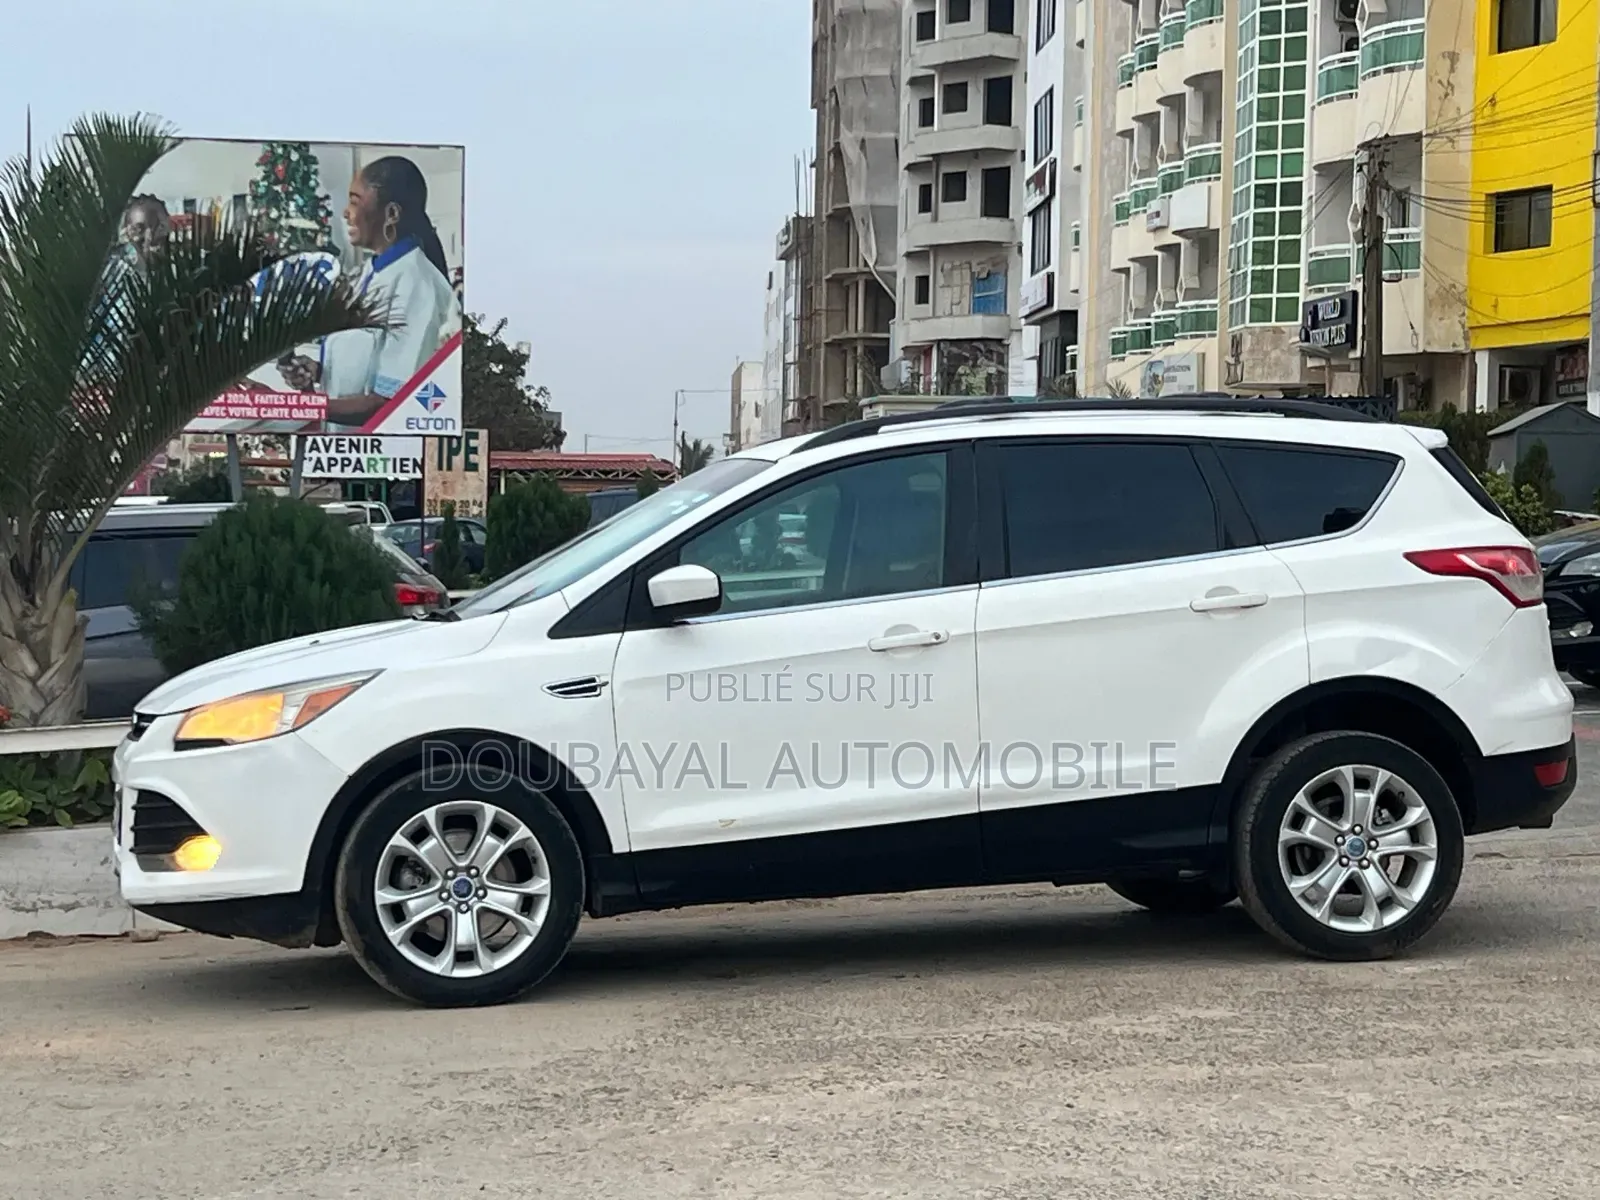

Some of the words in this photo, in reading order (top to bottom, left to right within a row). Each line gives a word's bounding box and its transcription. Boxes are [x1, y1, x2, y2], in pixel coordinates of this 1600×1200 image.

[254, 393, 286, 405] FAITES
[287, 394, 298, 405] LE
[299, 395, 327, 406] PLEIN
[228, 406, 259, 418] VOTRE
[260, 407, 290, 419] CARTE
[291, 408, 319, 419] OASIS
